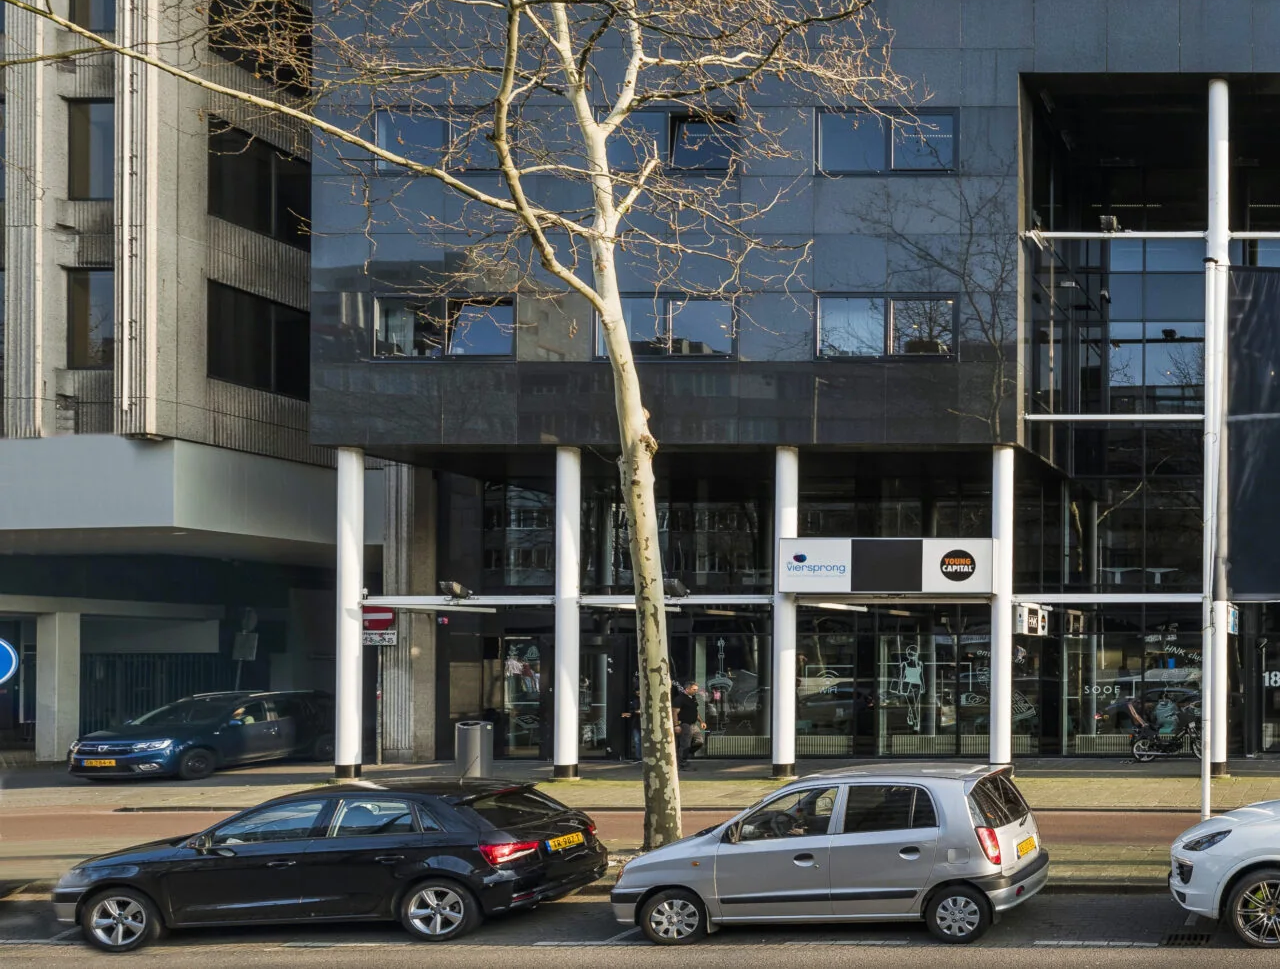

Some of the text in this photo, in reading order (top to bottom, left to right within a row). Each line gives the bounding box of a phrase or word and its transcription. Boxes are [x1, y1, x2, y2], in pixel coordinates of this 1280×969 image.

[944, 558, 971, 566] YOUNG
[787, 563, 846, 575] viersprong
[942, 564, 973, 573] CAPITAL
[1164, 644, 1186, 657] HNK
